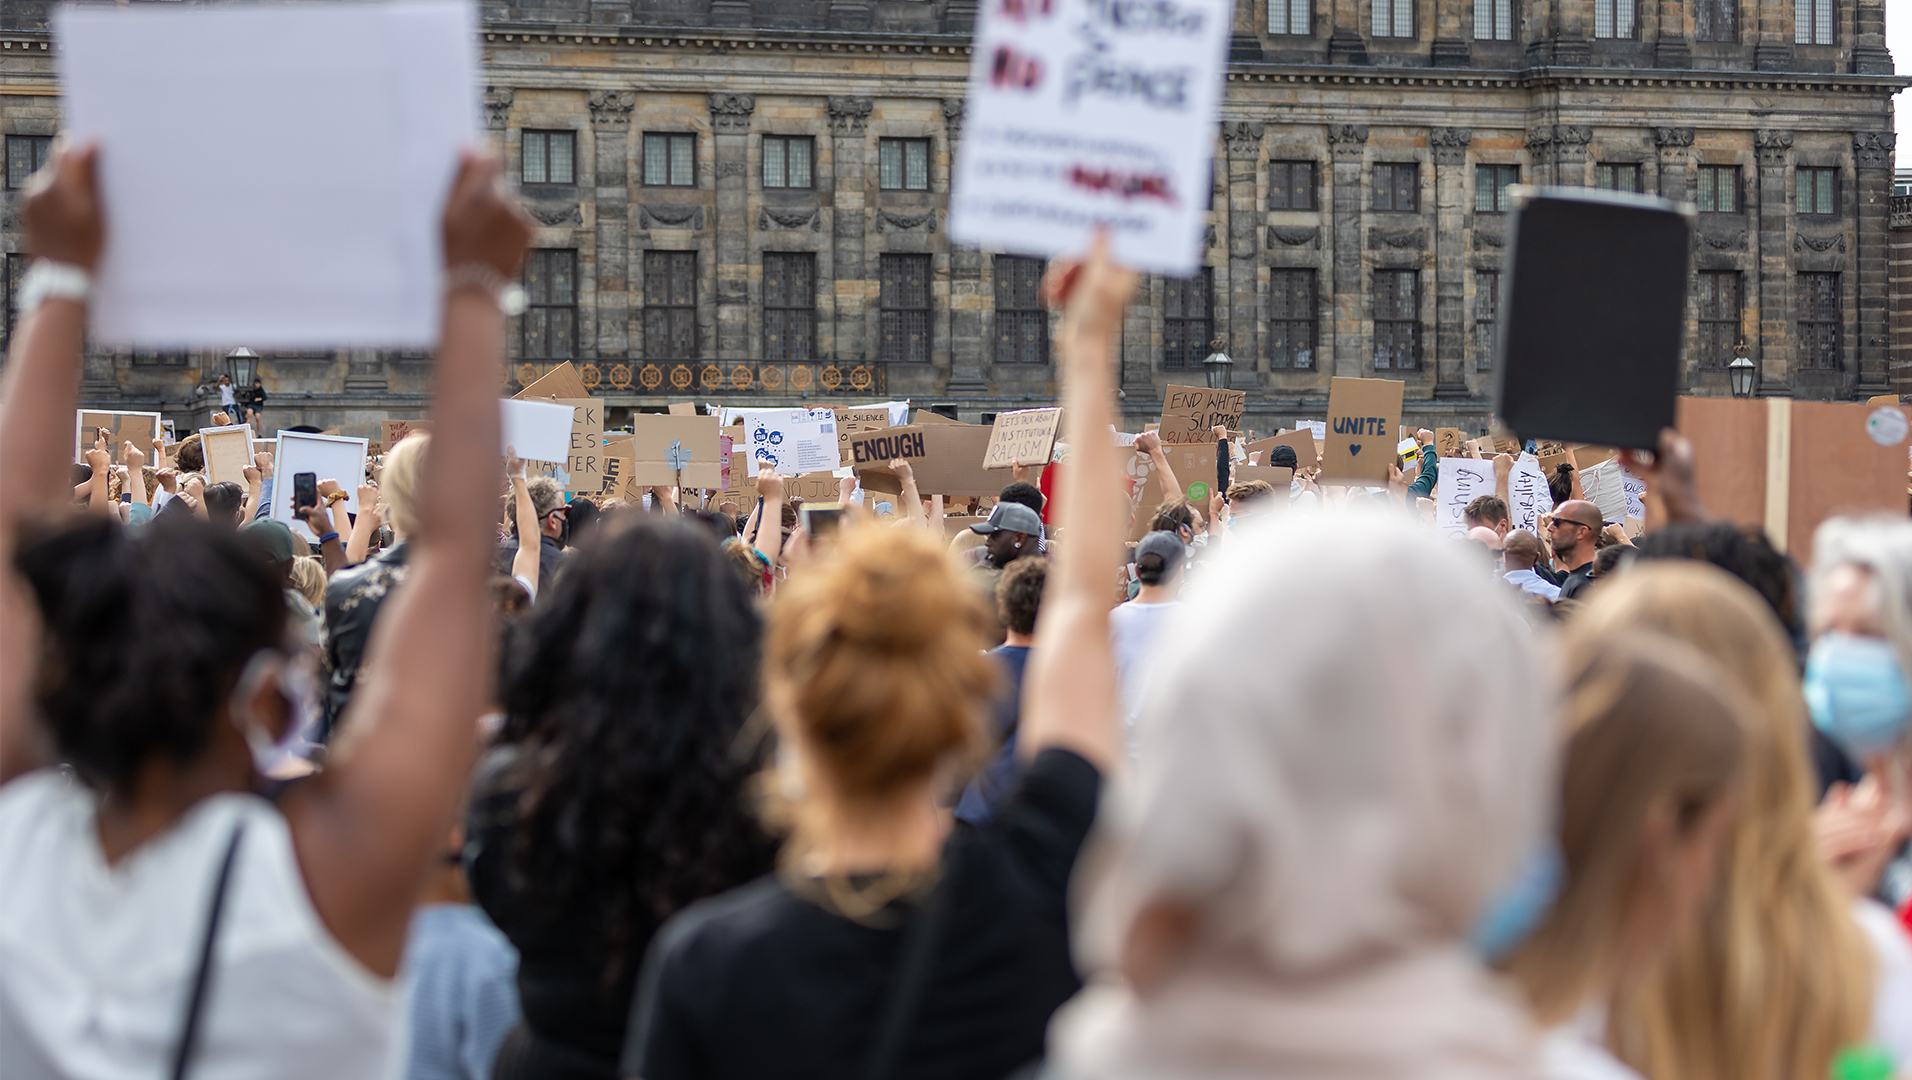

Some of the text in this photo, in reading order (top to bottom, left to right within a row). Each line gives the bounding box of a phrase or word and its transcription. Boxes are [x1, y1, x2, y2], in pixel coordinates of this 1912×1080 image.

[1170, 392, 1244, 413] END WHITE
[573, 407, 596, 425] CK
[852, 413, 885, 422] SILENCE
[1035, 413, 1056, 423] ABOUT
[1333, 417, 1387, 436] UNITE
[571, 433, 596, 449] ES
[853, 432, 926, 463] ENOUGH
[992, 440, 1042, 462] RACISM
